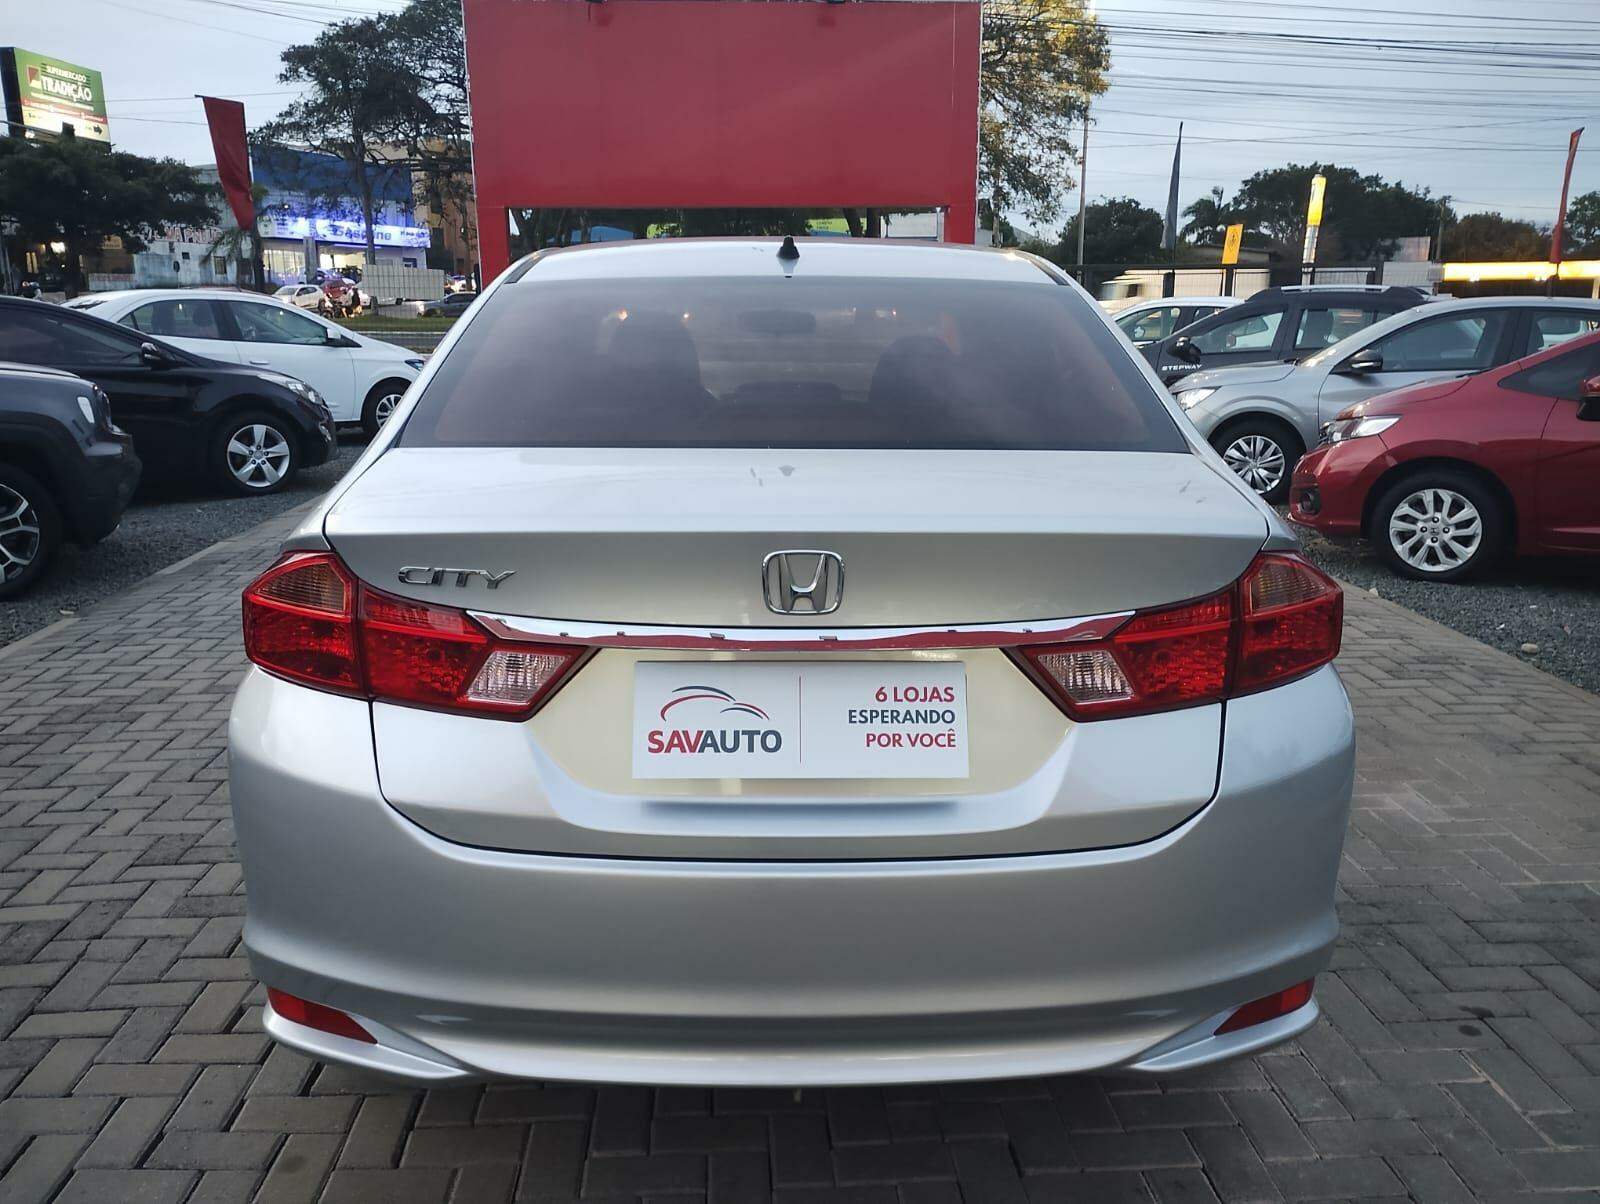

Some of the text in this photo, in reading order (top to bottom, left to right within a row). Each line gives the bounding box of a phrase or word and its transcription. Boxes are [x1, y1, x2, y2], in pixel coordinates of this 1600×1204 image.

[41, 76, 92, 102] TRADIÇÃO
[398, 565, 517, 589] CITY
[874, 686, 955, 703] 6 LOJAS
[848, 709, 956, 724] ESPERANDO
[647, 730, 782, 754] SAVAUTO
[866, 729, 957, 748] POR VOCÊ
